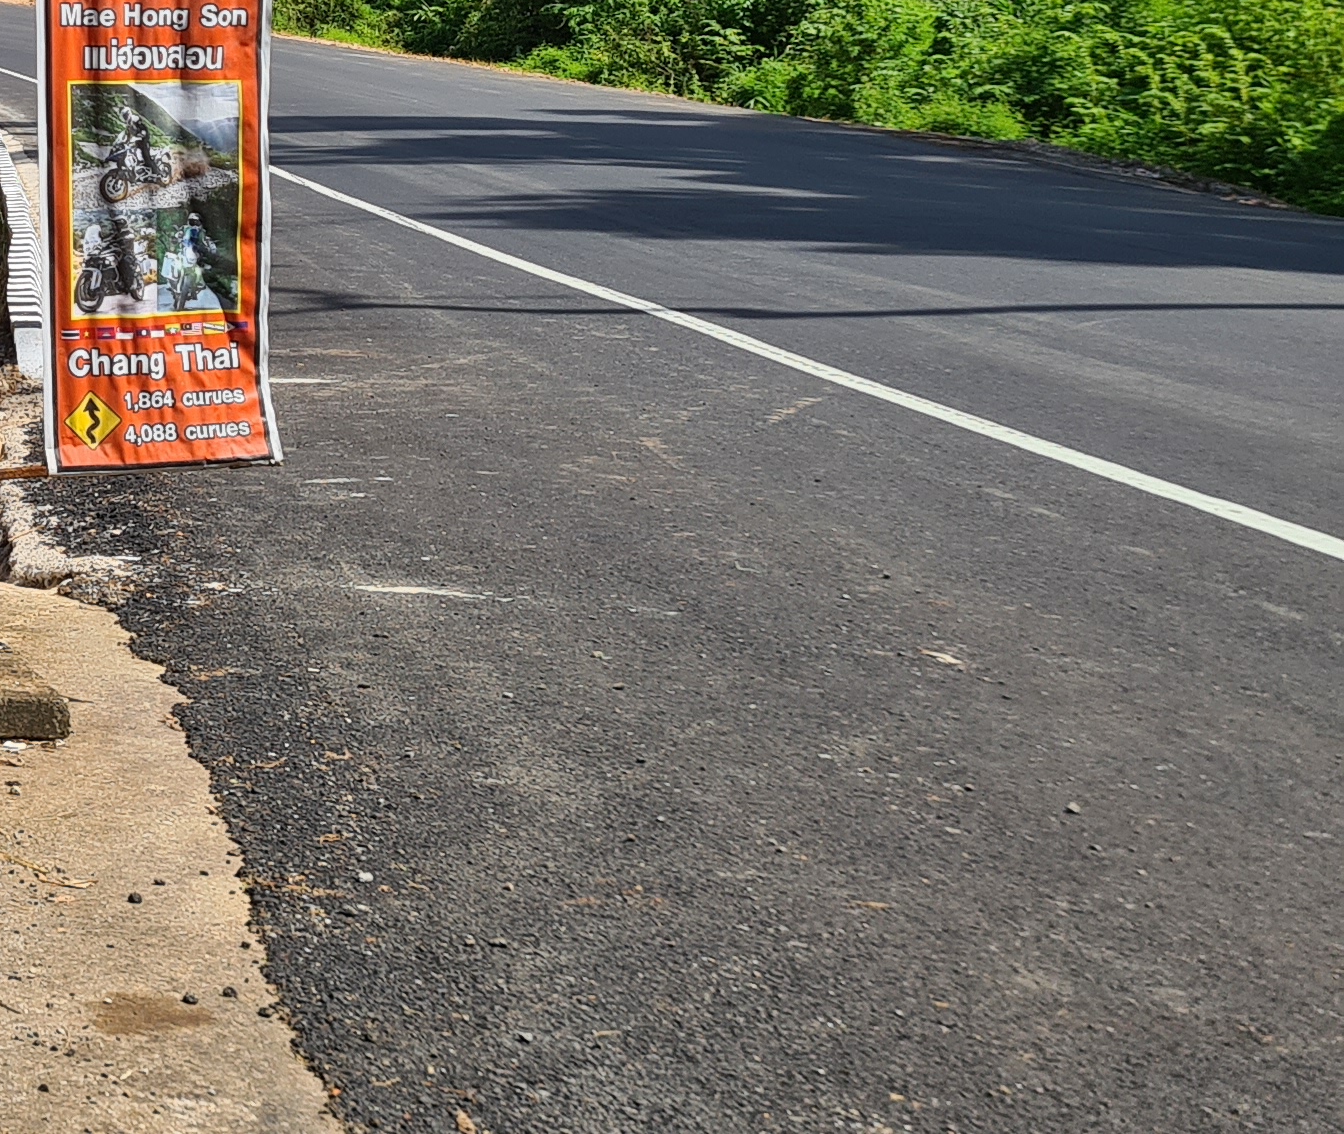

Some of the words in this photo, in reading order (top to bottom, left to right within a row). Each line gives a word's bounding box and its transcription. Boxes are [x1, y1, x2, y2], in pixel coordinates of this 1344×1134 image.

[60, 3, 116, 27] Mae
[123, 3, 189, 31] Hong
[200, 6, 248, 27] Son
[83, 37, 224, 71] แม่ฮ่องสอน
[67, 347, 165, 380] Chang
[174, 341, 241, 373] Thai
[124, 389, 175, 413] 1,864
[124, 423, 179, 446] 4,088
